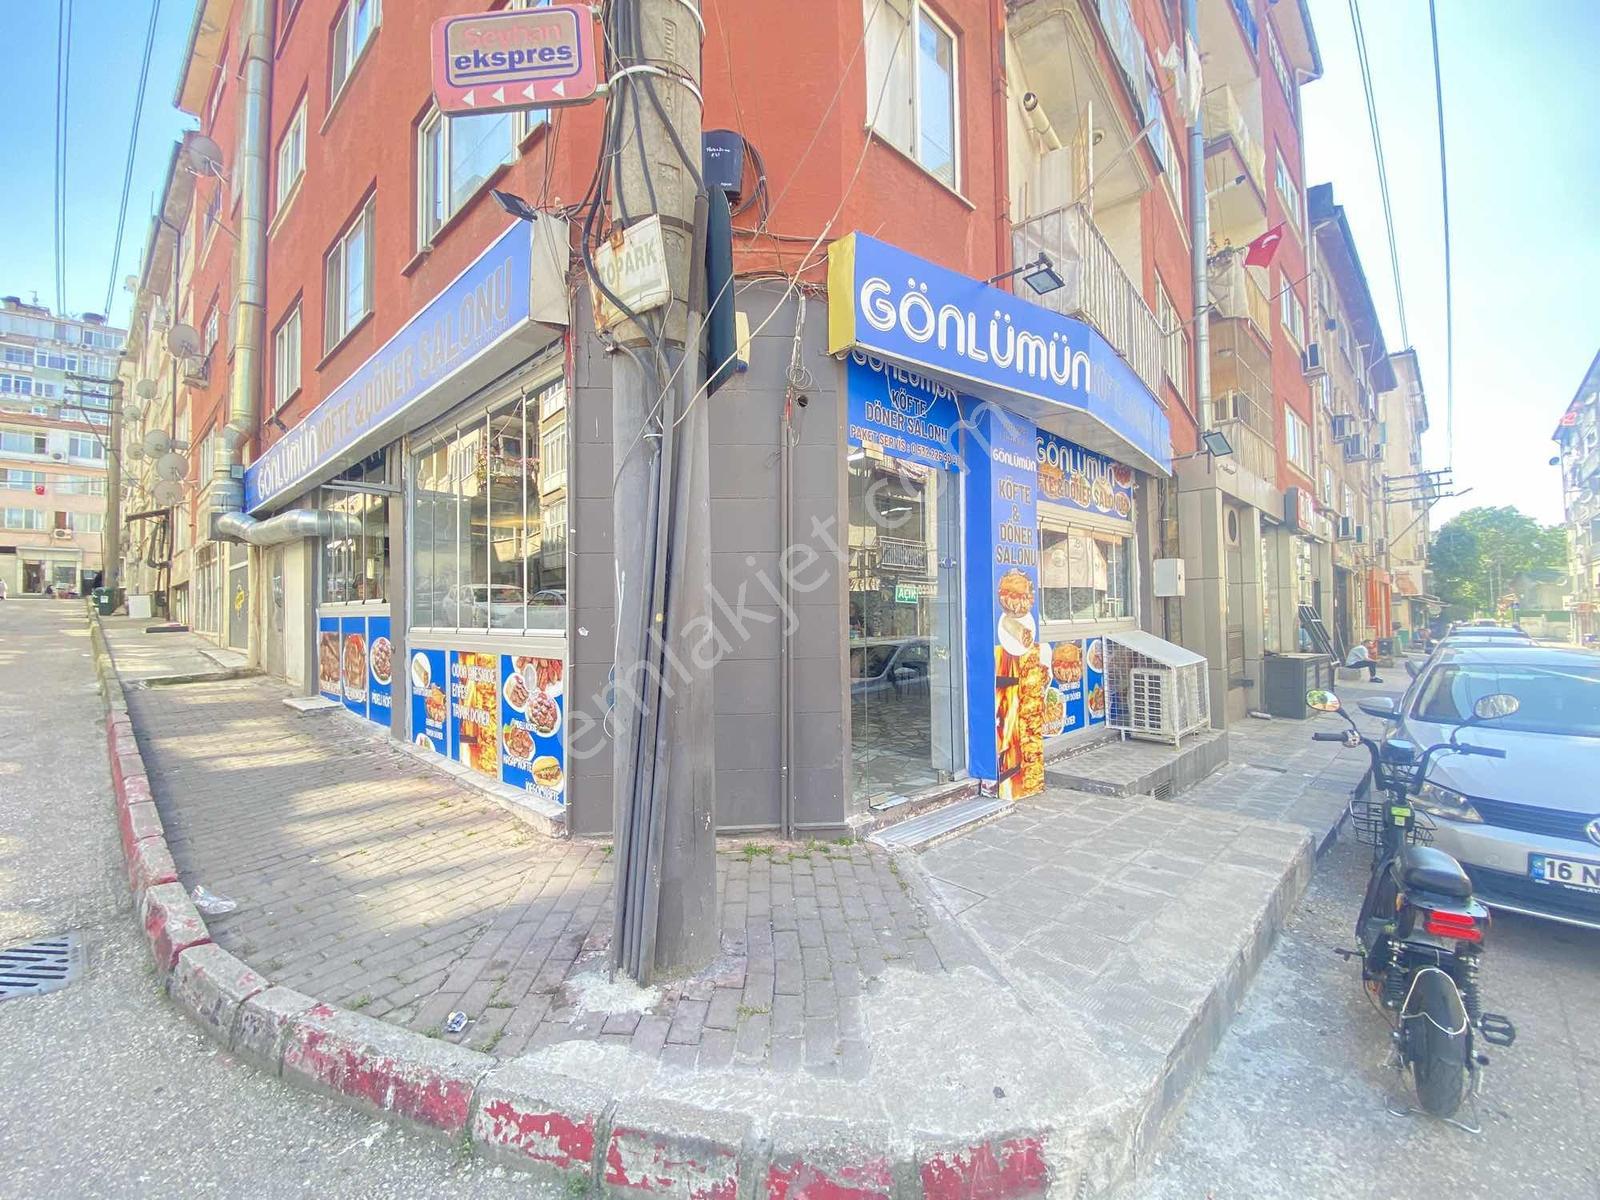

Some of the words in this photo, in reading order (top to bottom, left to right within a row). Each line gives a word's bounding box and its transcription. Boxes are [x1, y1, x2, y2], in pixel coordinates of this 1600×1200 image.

[454, 45, 573, 70] ekspres
[860, 277, 1091, 393] GÖNLÜMÜN
[257, 422, 318, 500] GÖNLÜMÜN
[419, 256, 512, 379] SALONU
[891, 387, 929, 418] KÖFTE
[865, 399, 906, 432] DÖNER
[907, 416, 949, 445] SALONU
[850, 424, 878, 443] PAKET
[879, 433, 908, 453] SERVİS
[992, 447, 1036, 472] GÖNLÜMÜN
[1036, 436, 1115, 487] GÖNLÜMÜN
[999, 473, 1031, 504] KÖFTE
[1011, 503, 1020, 523] &
[1000, 518, 1033, 545] DÖNER
[996, 544, 1036, 566] SALONU
[898, 586, 917, 601] AÇIK
[1546, 860, 1572, 880] 16
